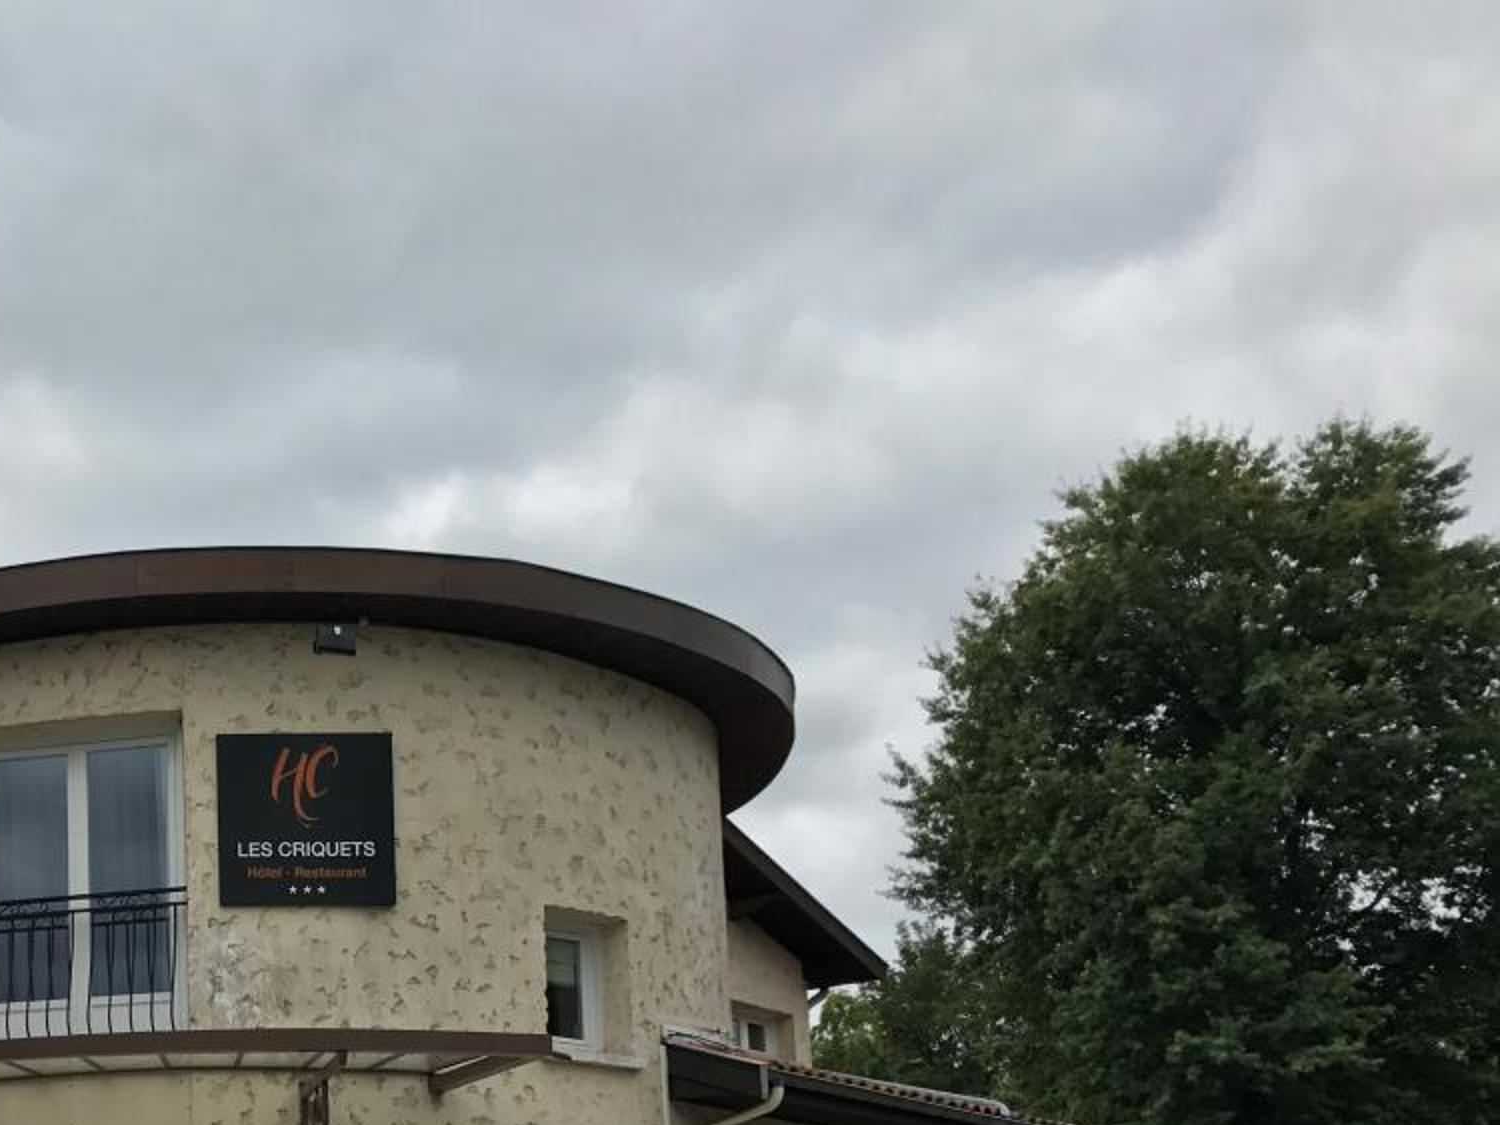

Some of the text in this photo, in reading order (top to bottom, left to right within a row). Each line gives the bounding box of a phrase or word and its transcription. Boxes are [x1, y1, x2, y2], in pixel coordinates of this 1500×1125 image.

[237, 841, 376, 857] LES CRIQUETS
[294, 866, 367, 879] Restaurant
